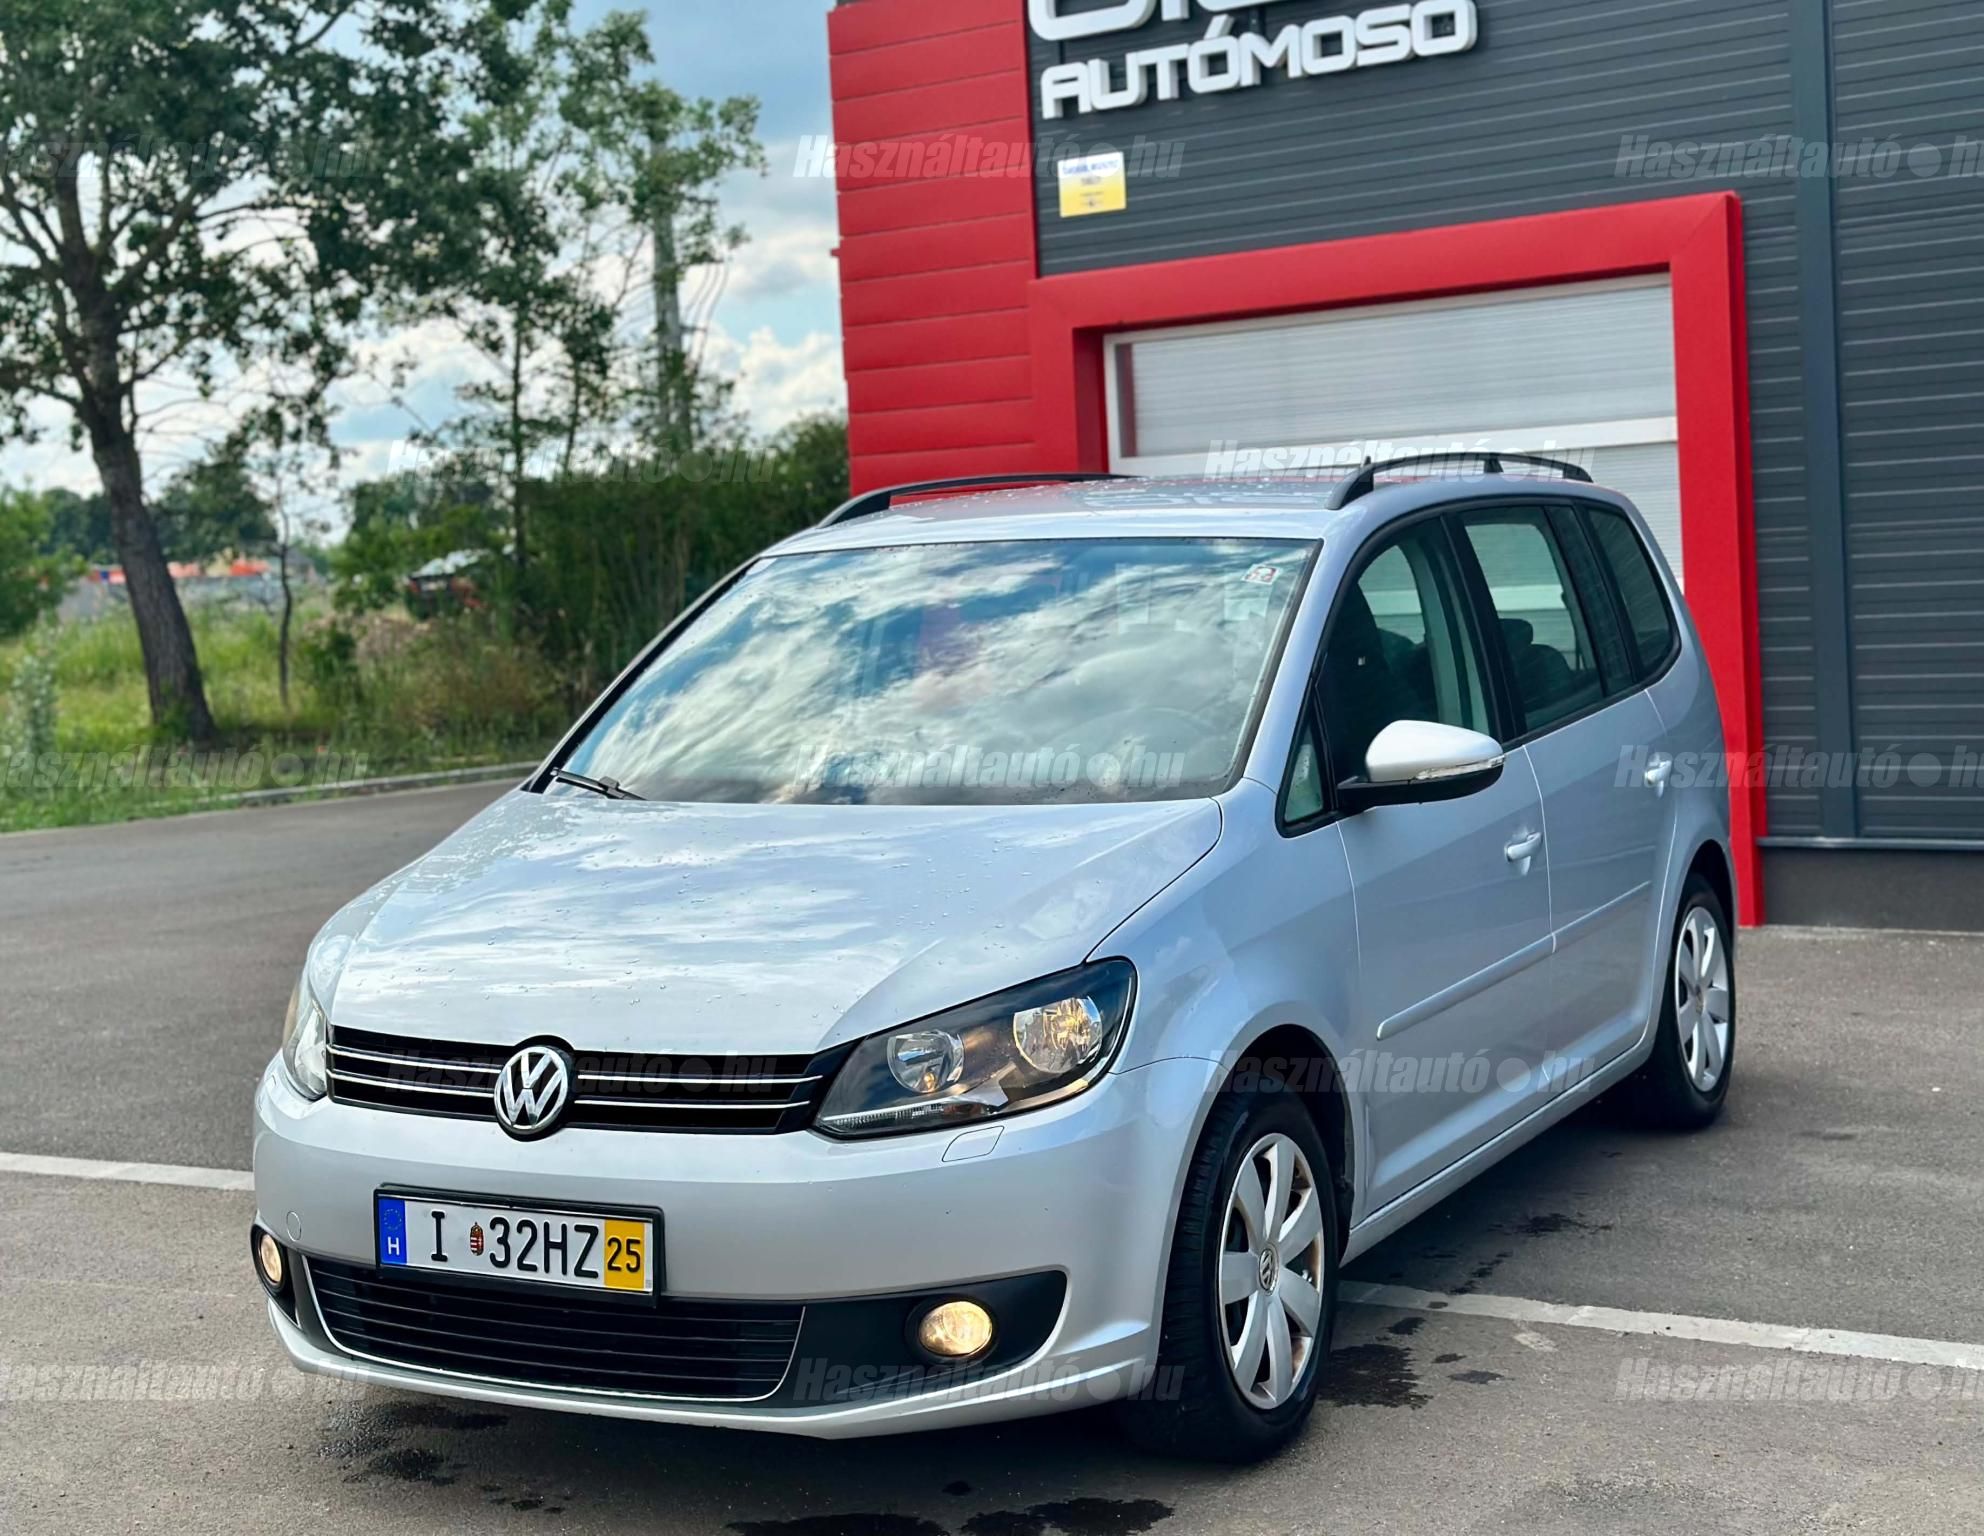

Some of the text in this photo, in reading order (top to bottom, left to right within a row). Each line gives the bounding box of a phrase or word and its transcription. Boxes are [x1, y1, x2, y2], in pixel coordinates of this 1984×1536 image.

[387, 1236, 400, 1256] H
[489, 1216, 599, 1279] 32HZ
[606, 1236, 642, 1273] 25
